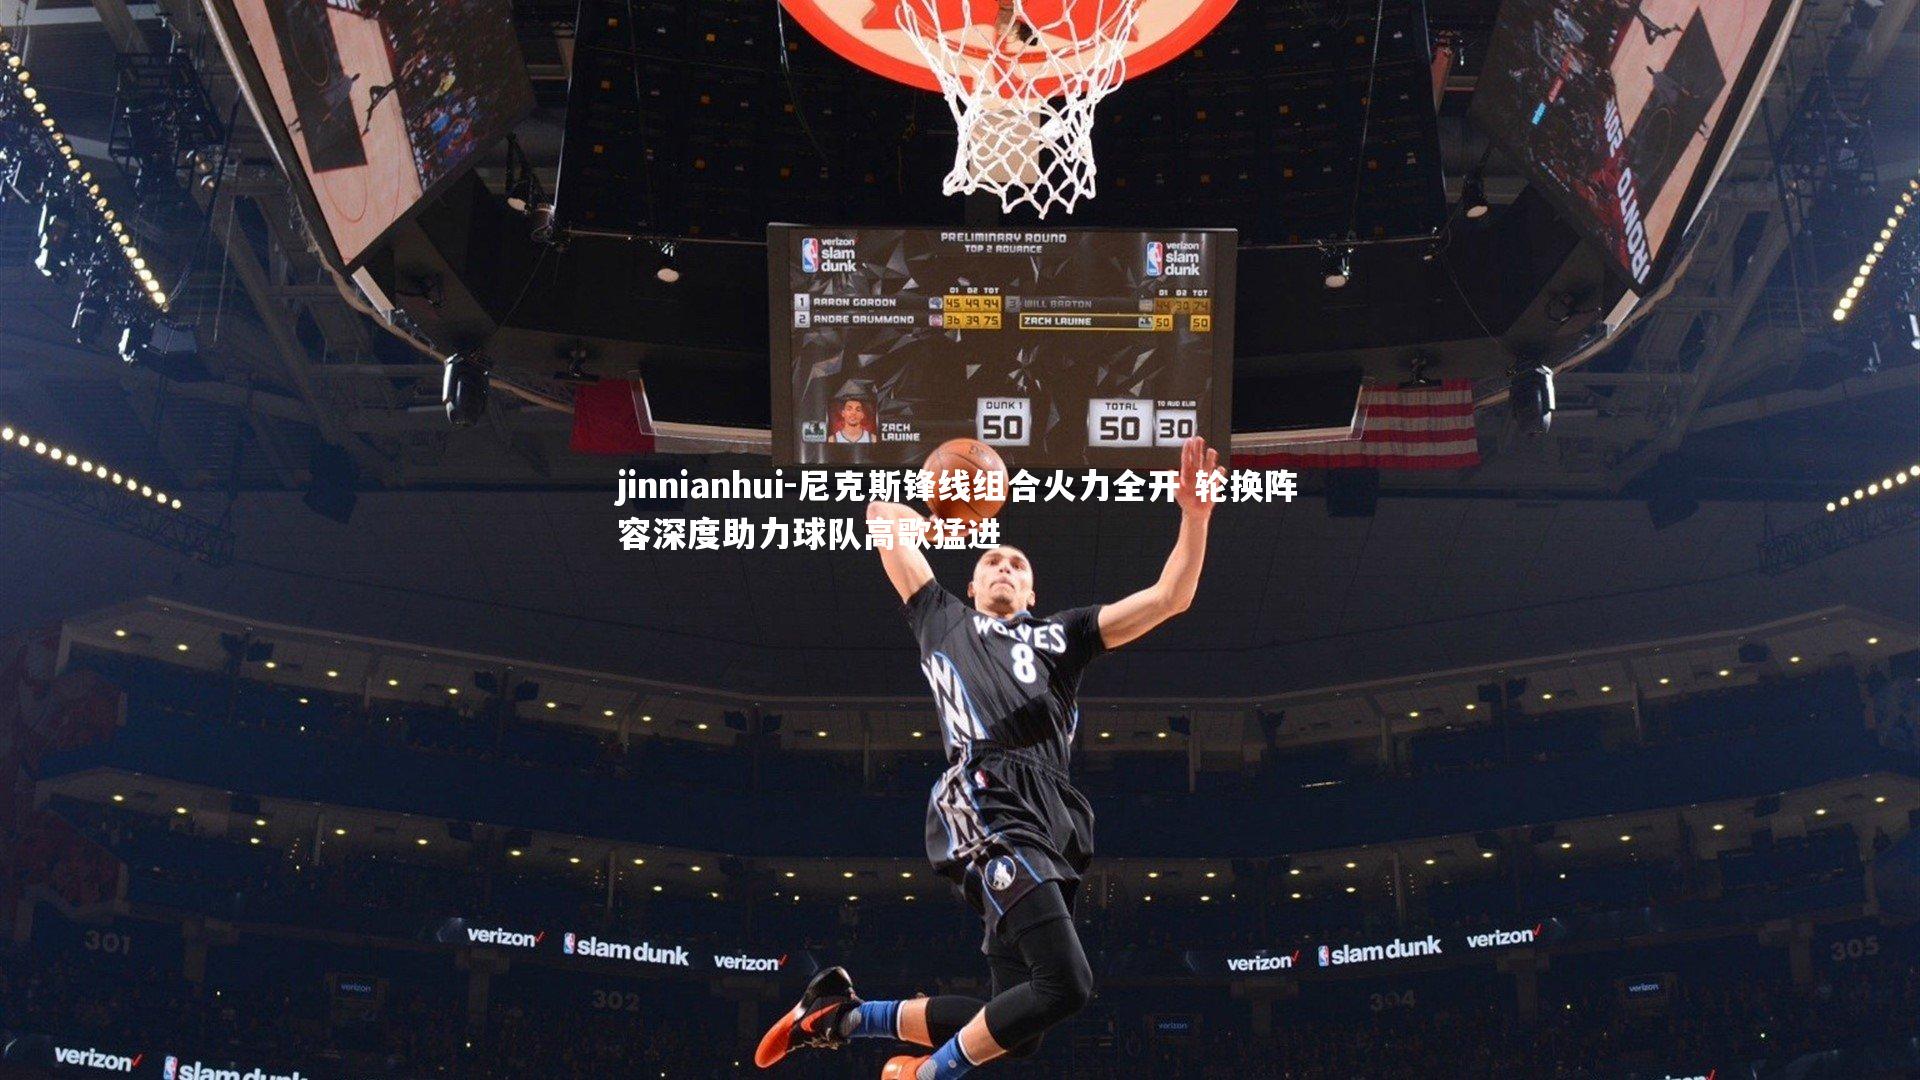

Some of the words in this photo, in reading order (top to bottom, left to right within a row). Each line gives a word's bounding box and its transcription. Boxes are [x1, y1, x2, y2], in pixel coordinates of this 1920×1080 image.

[821, 237, 856, 246] verizon
[941, 232, 1021, 242] PRELIMINARY
[1025, 232, 1067, 243] ROUND
[965, 244, 983, 253] TOP
[995, 245, 1042, 254] ADVANCE
[1165, 241, 1200, 250] verizon
[821, 247, 856, 260] slam
[1165, 250, 1200, 263] slam
[821, 259, 857, 272] dunk
[1165, 263, 1200, 276] dunk
[813, 298, 849, 307] AARON
[853, 298, 897, 307] GORDON
[946, 299, 960, 308] 45
[965, 299, 979, 308] 49
[983, 299, 999, 308] 94
[1024, 300, 1047, 309] WILL
[1050, 300, 1092, 309] BARTON
[813, 315, 850, 324] ANDRE
[852, 315, 915, 325] DRUMMOND
[966, 316, 979, 325] 39
[984, 316, 999, 325] 75
[1024, 316, 1052, 326] ZACH
[1054, 316, 1092, 326] LAVINE
[1156, 318, 1170, 327] 50
[1193, 318, 1208, 327] 50
[986, 401, 1015, 410] DUNK
[1105, 402, 1138, 411] TOTAL
[881, 423, 911, 432] ZACH
[983, 415, 1023, 440] 50
[1100, 416, 1140, 441] 50
[1160, 418, 1193, 439] 30
[881, 433, 920, 442] LAVINE
[1011, 643, 1037, 684] 8
[467, 927, 536, 948] verizon
[1467, 929, 1534, 948] verizon
[576, 935, 631, 960] slam
[632, 942, 690, 967] dunk
[1331, 944, 1384, 965] slam
[1385, 935, 1443, 960] dunk
[713, 954, 779, 971] verizon
[1227, 949, 1292, 972] verizon
[54, 1046, 132, 1073] verizon
